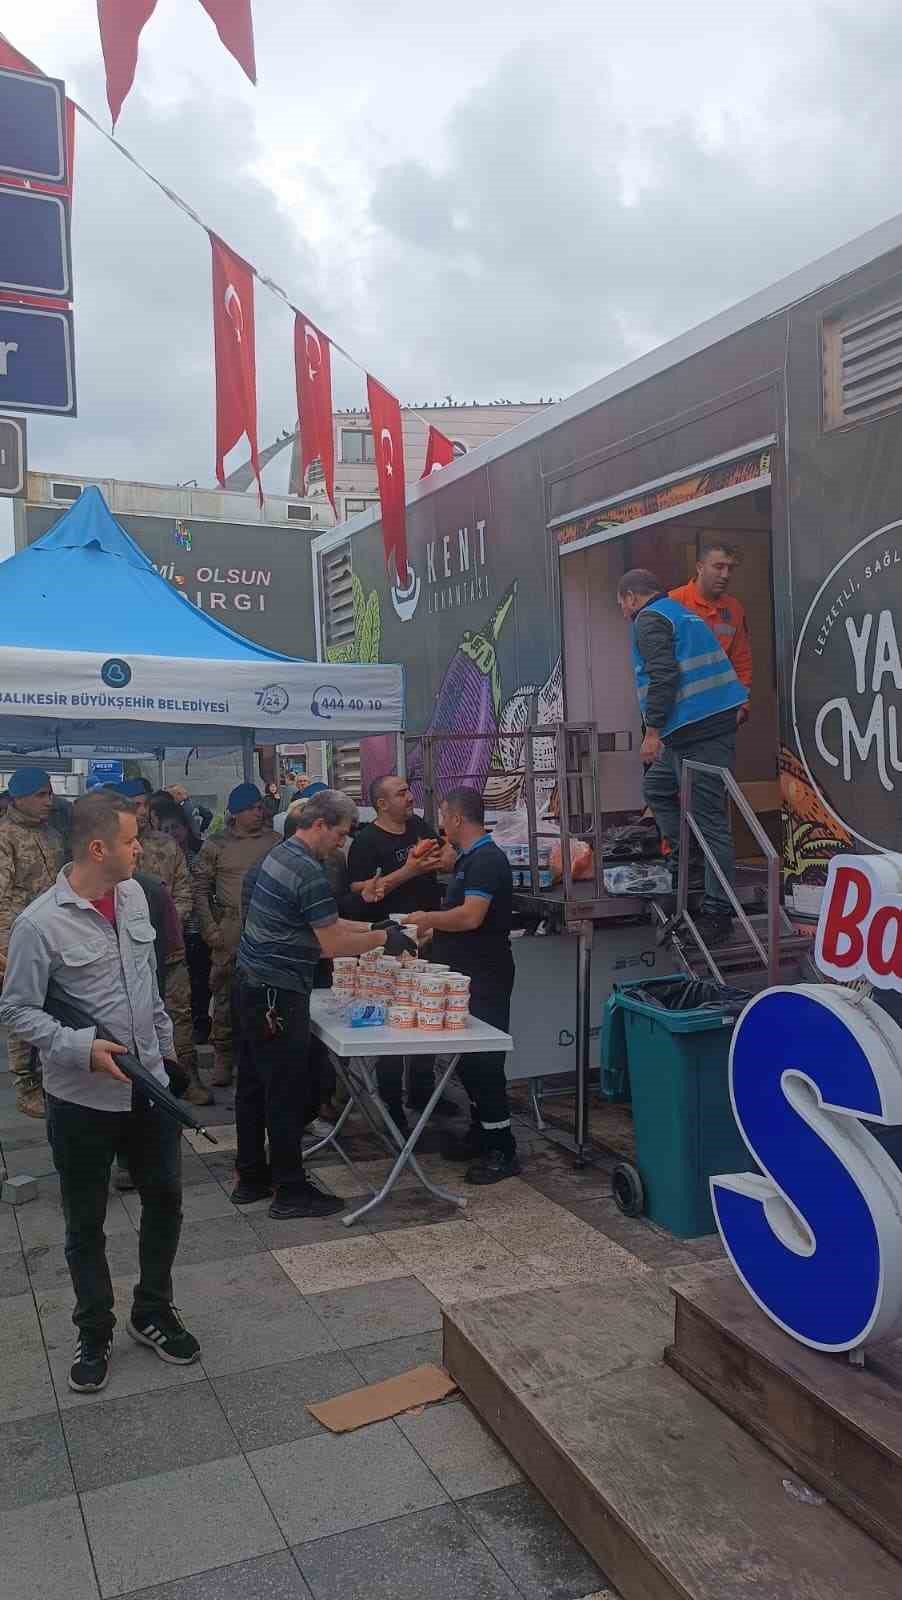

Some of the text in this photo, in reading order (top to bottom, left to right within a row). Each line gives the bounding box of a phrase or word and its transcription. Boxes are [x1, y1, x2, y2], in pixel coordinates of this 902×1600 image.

[426, 520, 486, 583] KENT
[196, 567, 271, 586] OLSUN
[72, 693, 154, 709] BÜYÜKŞEHİR
[158, 696, 230, 713] BELEDİYESİ
[321, 698, 382, 711] 444 40 10
